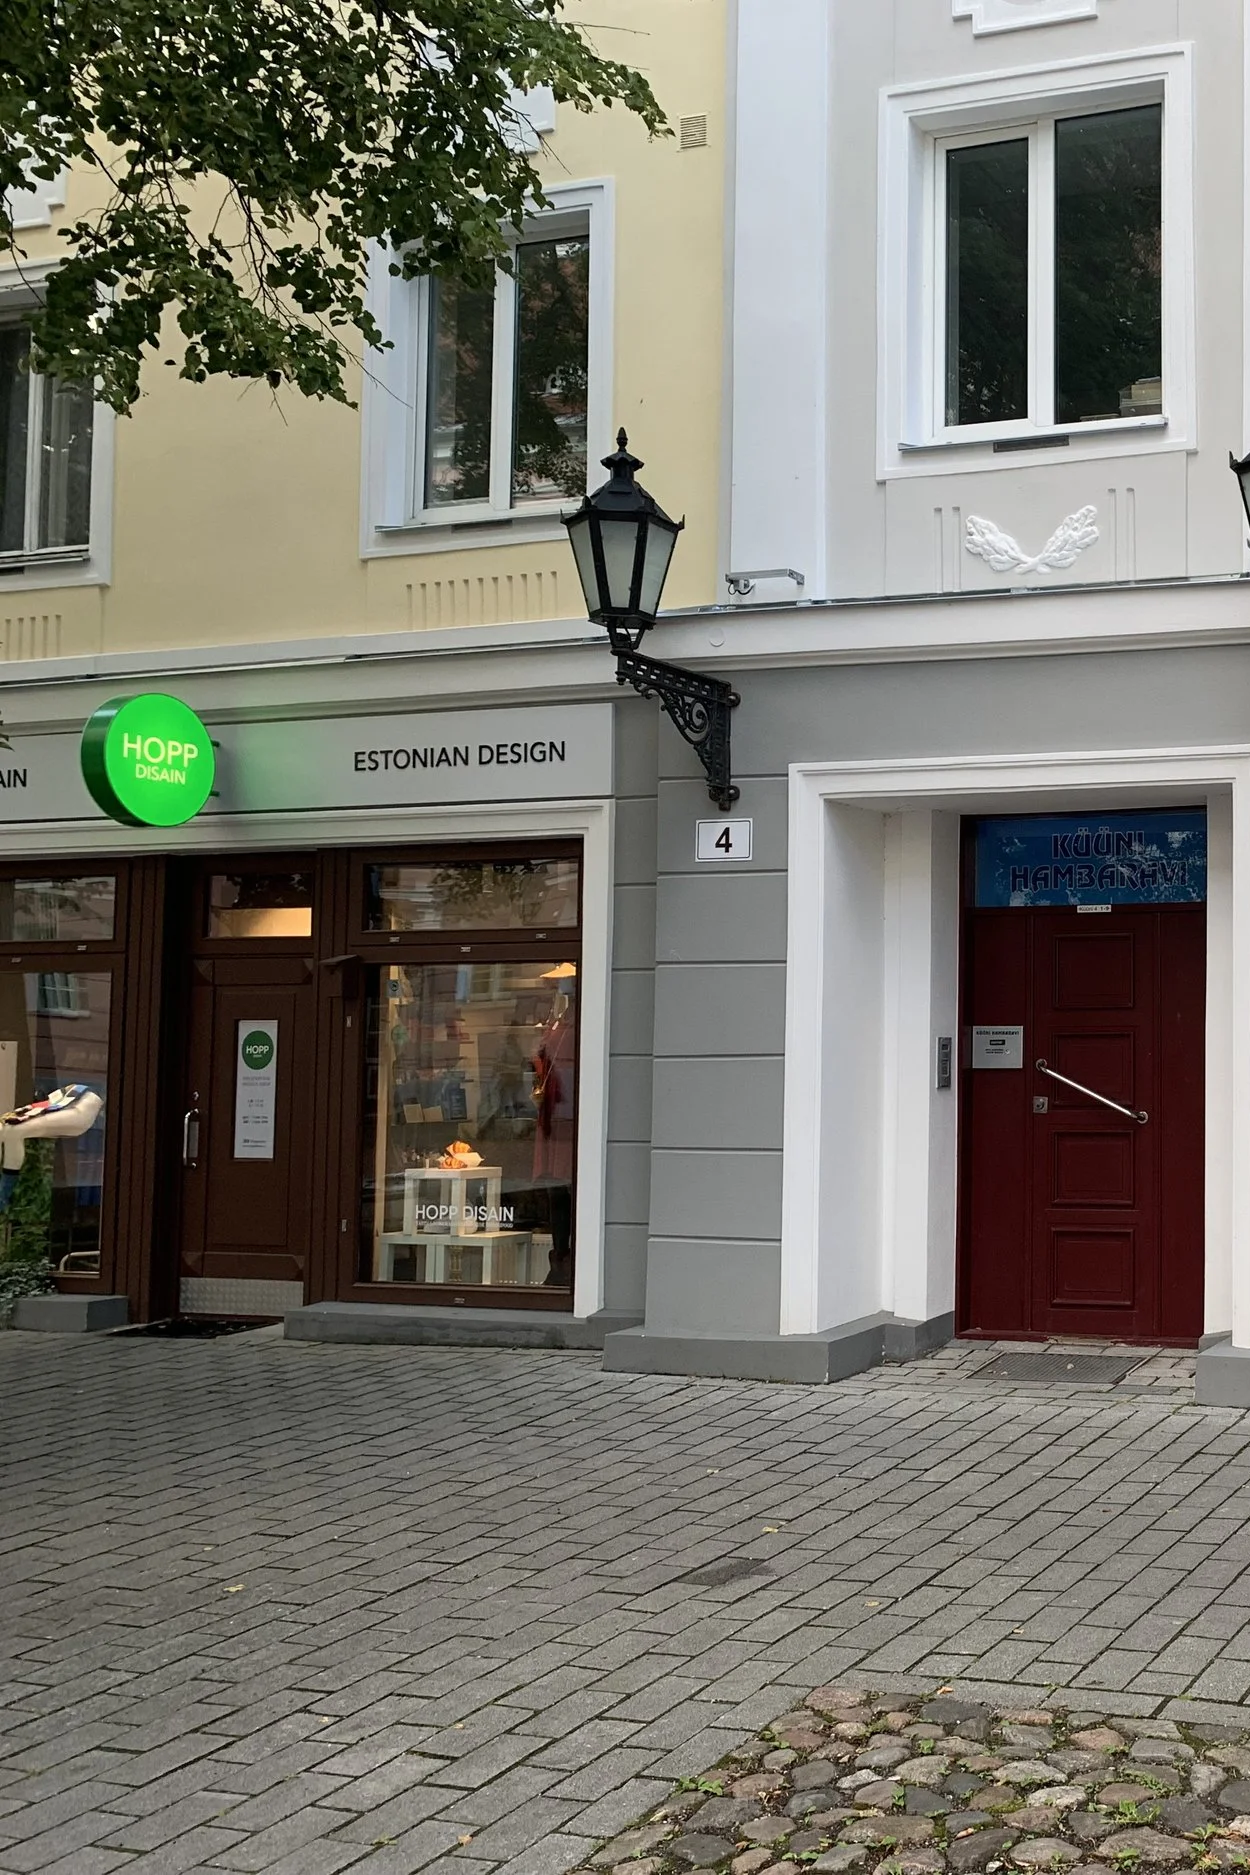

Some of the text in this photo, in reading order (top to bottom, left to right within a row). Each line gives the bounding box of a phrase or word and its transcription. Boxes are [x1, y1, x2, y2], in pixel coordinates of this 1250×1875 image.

[122, 732, 199, 768] HOPP
[353, 741, 566, 771] ESTONIAN DESIGN
[135, 763, 187, 785] DISAIN
[714, 826, 733, 854] 4
[1051, 827, 1145, 859] KÜÜNI
[1010, 861, 1188, 893] HAMBARAVI
[245, 1045, 270, 1055] HOPP
[415, 1204, 514, 1222] HOPP DISAIN
